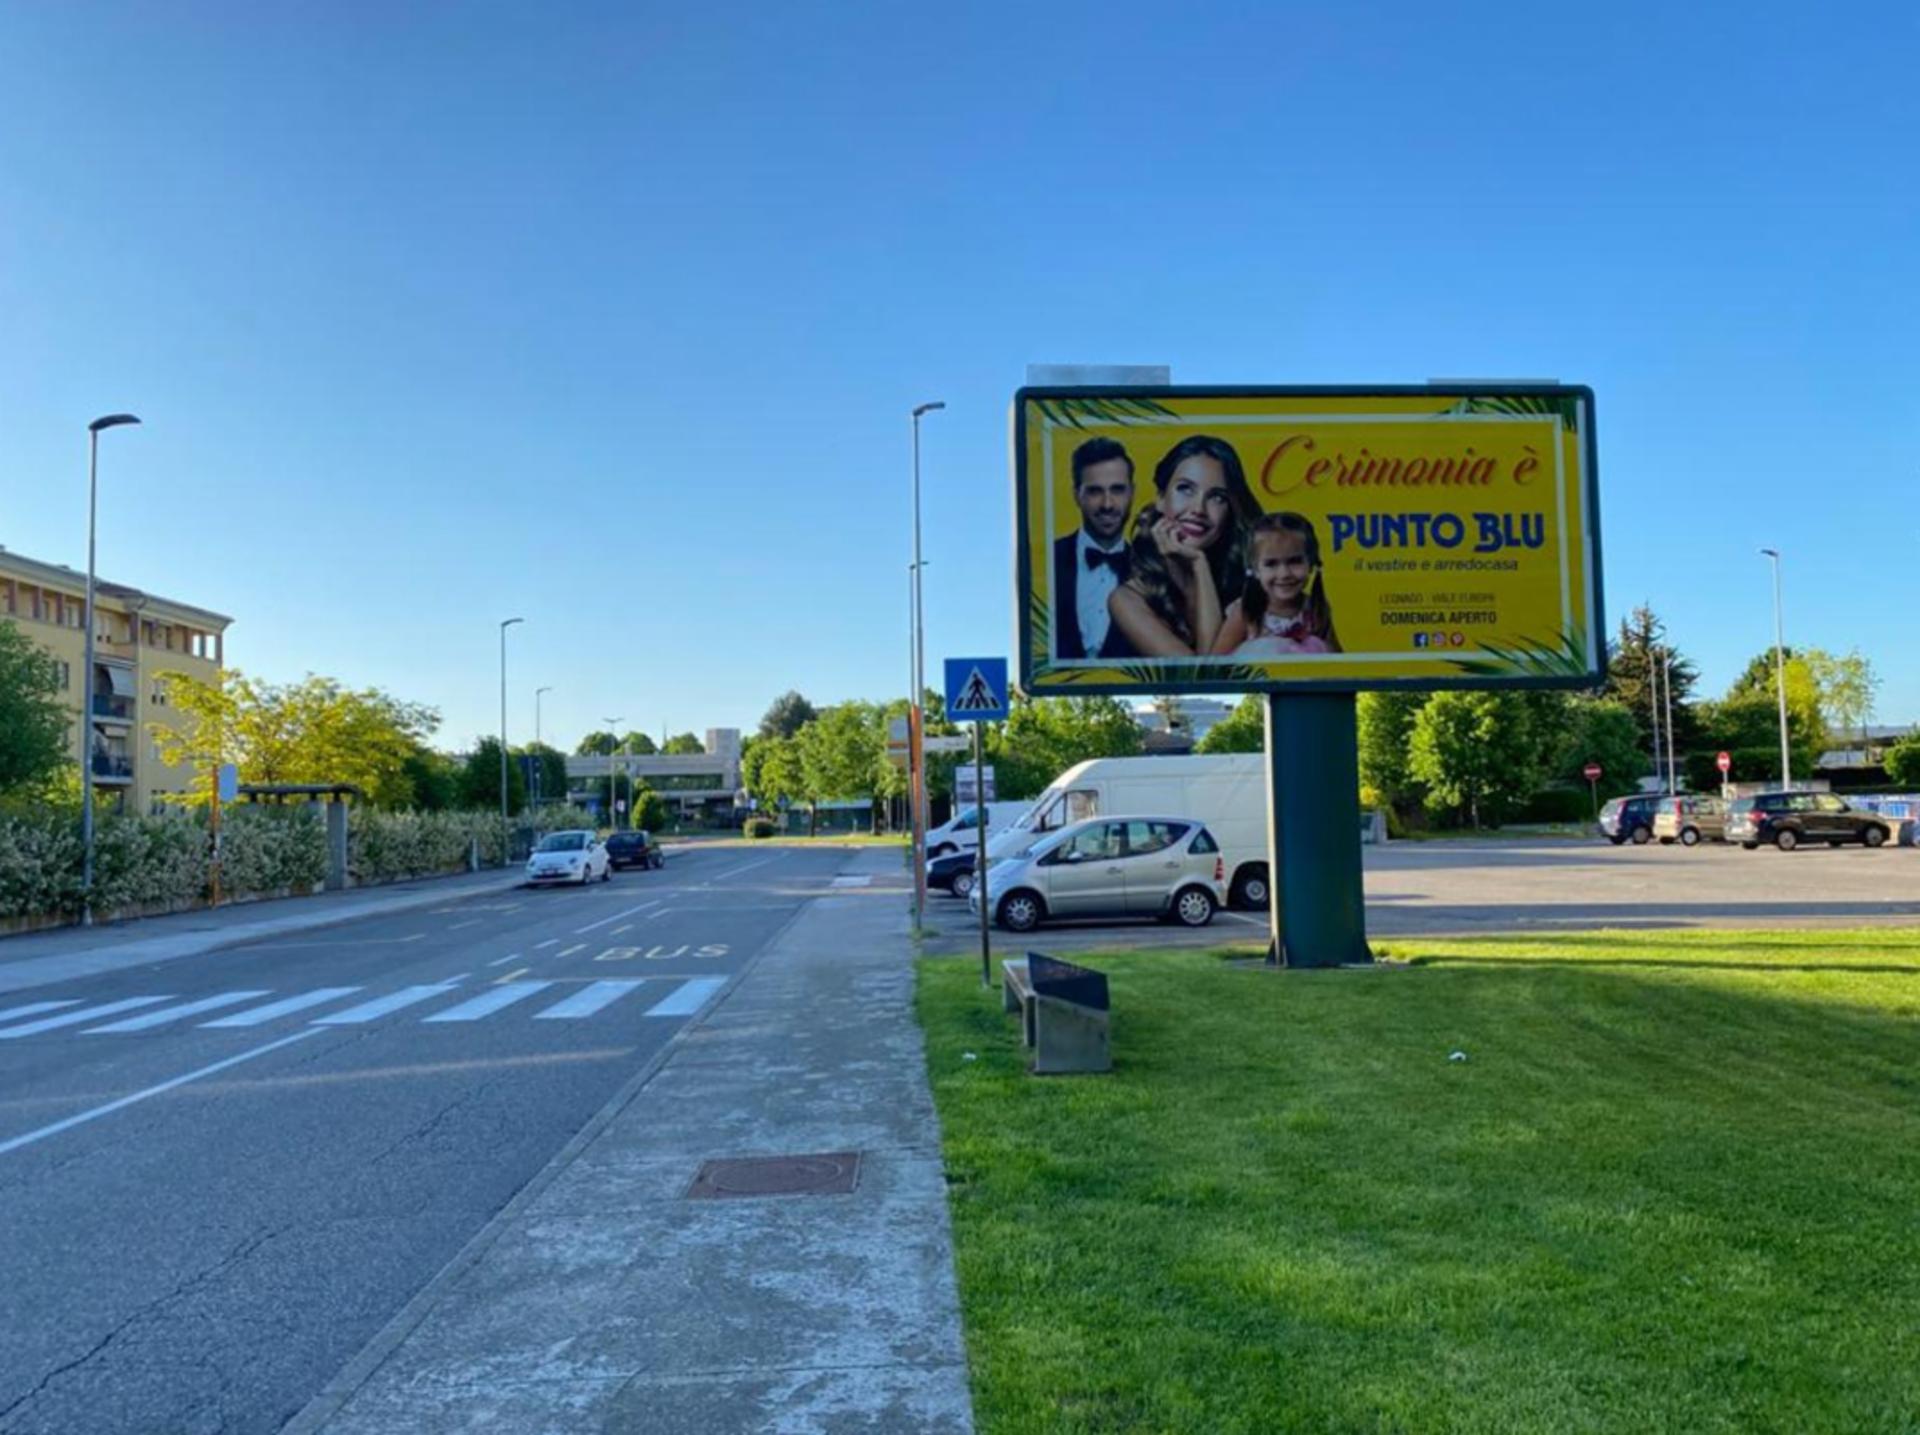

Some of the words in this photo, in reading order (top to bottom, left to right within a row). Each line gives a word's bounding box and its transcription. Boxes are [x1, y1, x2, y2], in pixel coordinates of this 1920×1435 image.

[1260, 435, 1497, 496] Cerimonia
[1512, 446, 1539, 486] è
[1326, 512, 1466, 553] PUNTO
[1472, 512, 1545, 553] BLU
[1354, 558, 1365, 571] il
[1367, 558, 1417, 571] vestire
[1421, 560, 1431, 571] e
[1434, 558, 1519, 571] arredocasa
[1381, 611, 1445, 625] DOMENICA
[1449, 611, 1498, 624] APERTO
[593, 943, 729, 961] BUS
